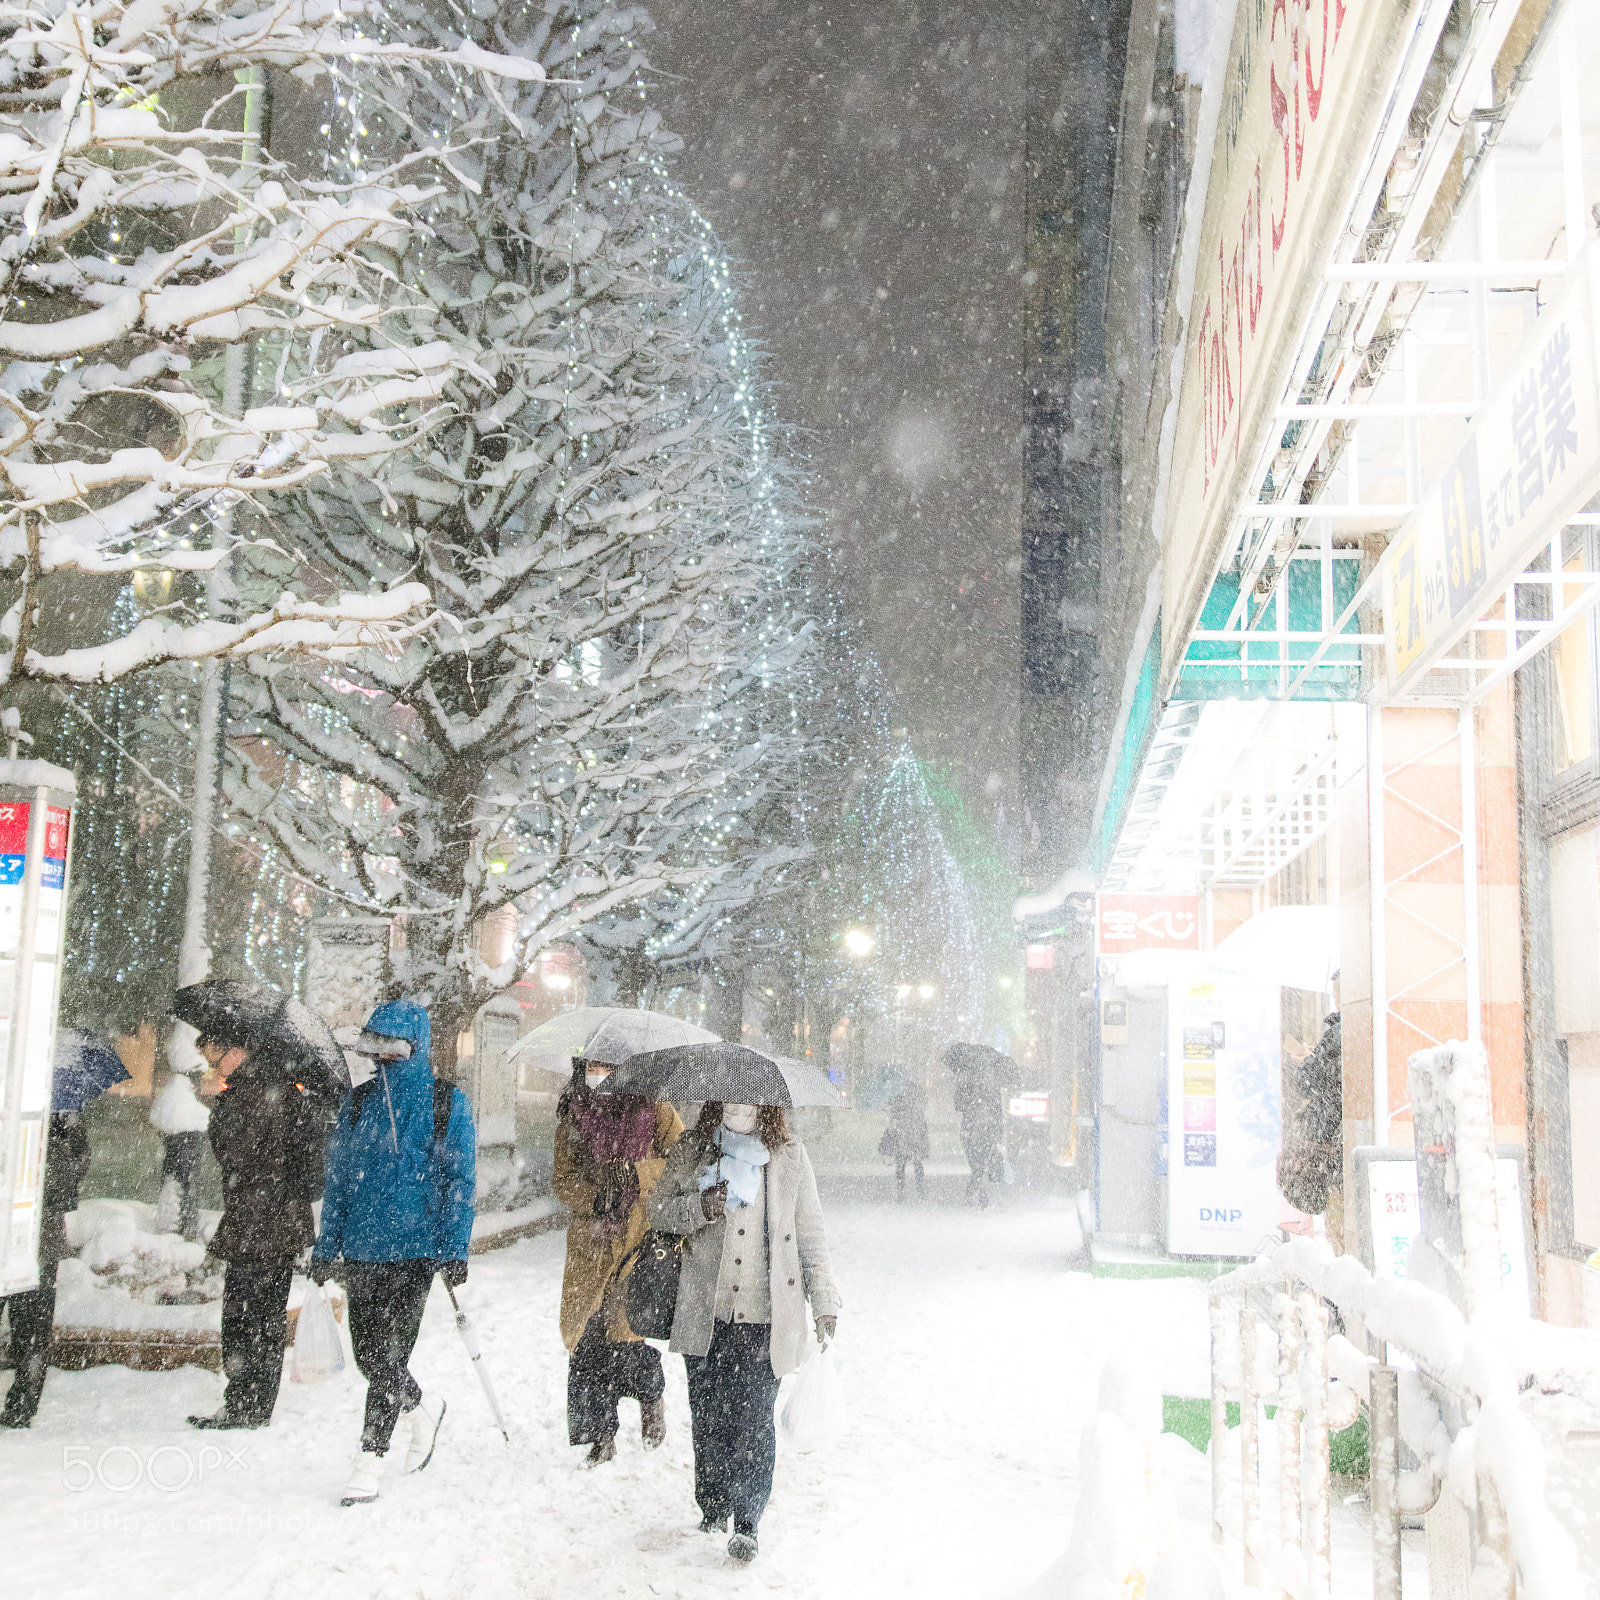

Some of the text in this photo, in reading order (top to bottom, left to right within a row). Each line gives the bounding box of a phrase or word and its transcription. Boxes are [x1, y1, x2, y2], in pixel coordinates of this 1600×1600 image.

[1102, 908, 1195, 940] 宝くじ
[1199, 1207, 1243, 1223] DNP
